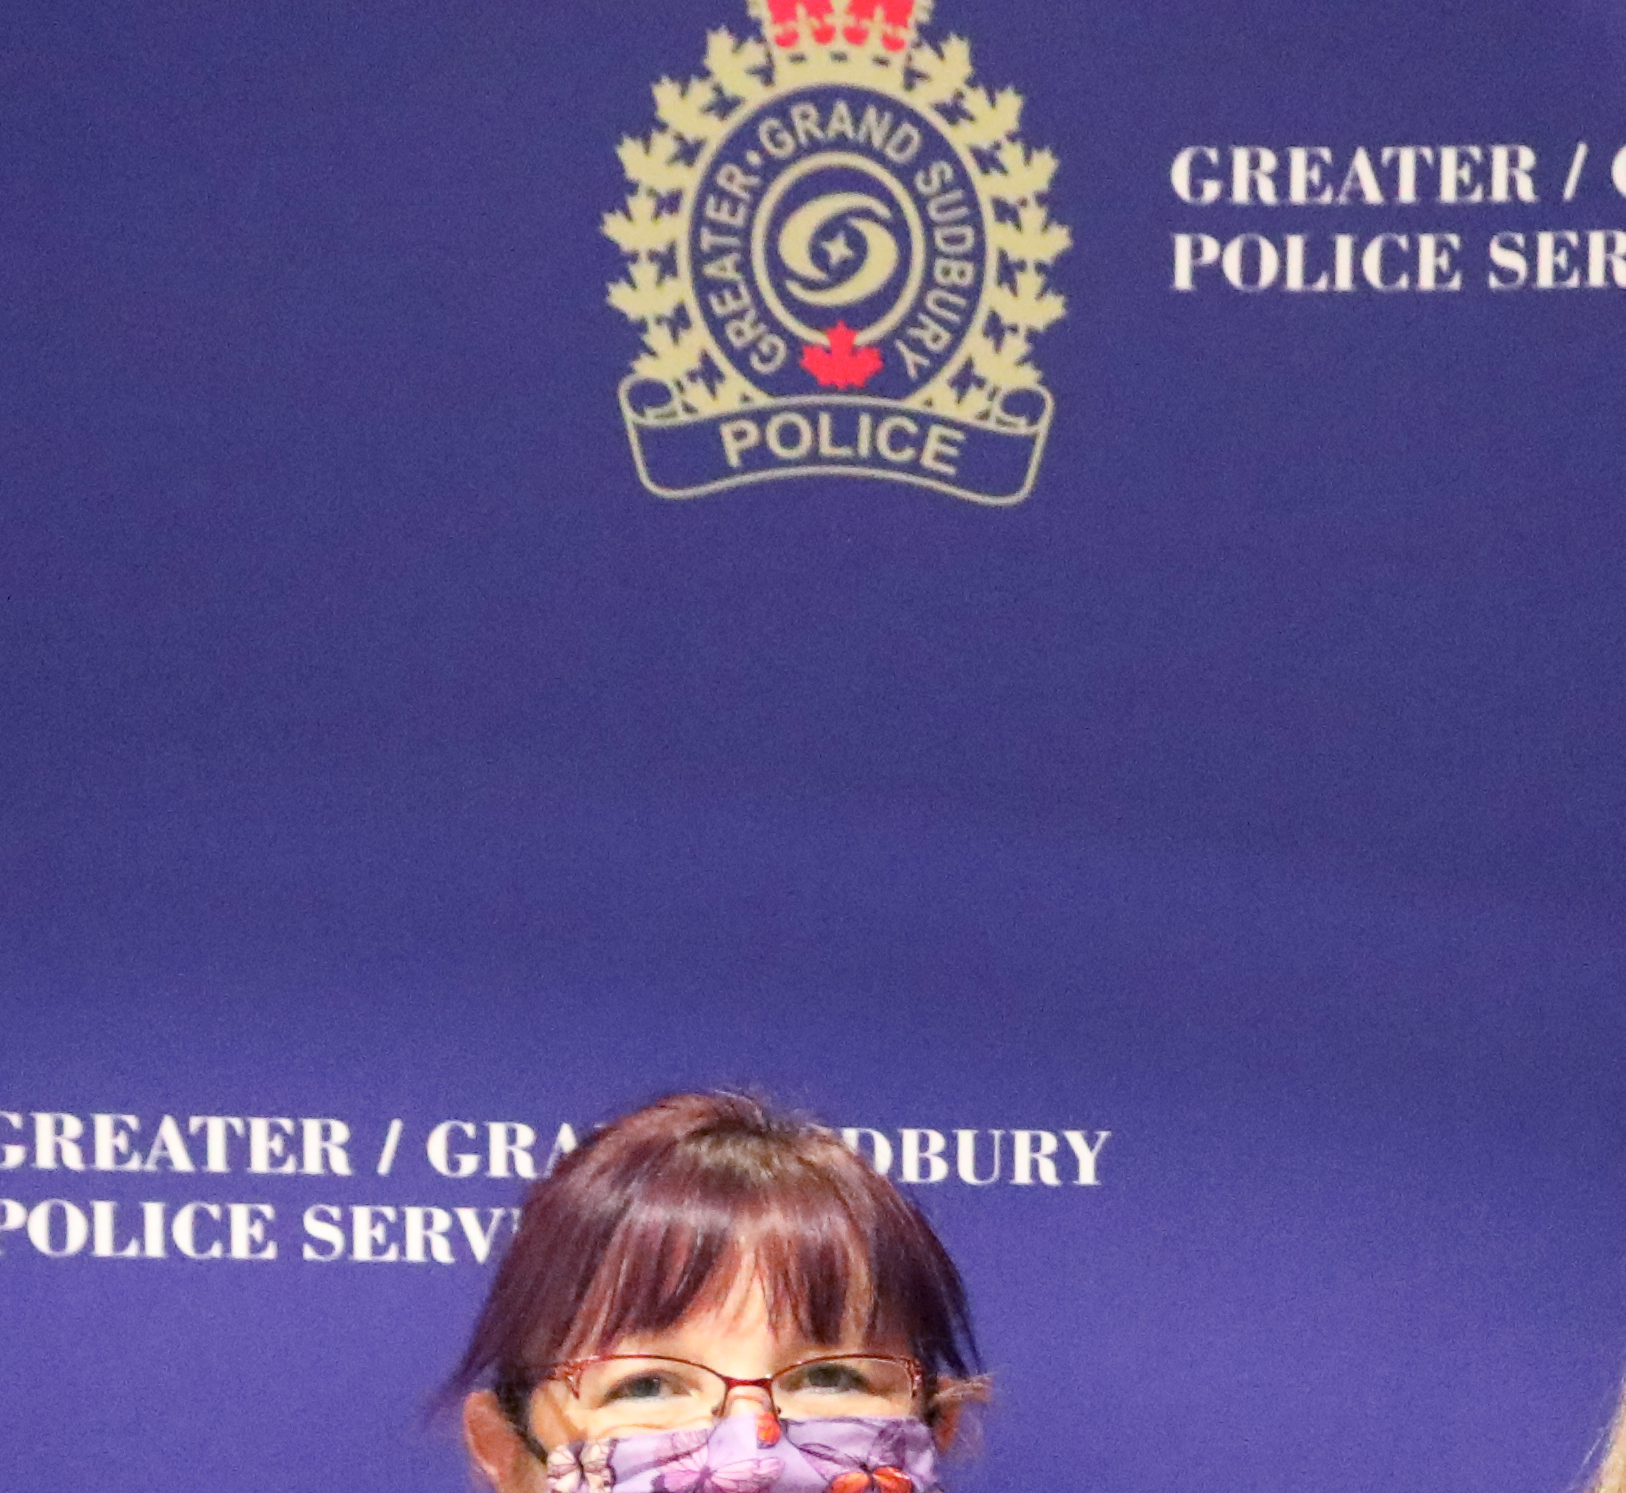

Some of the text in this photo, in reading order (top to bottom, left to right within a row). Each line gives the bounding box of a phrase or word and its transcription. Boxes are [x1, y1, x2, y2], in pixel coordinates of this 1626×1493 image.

[1170, 144, 1537, 206] GREATER
[1562, 142, 1589, 201] /
[699, 100, 975, 379] GREATER GRAND SUDBURY
[1173, 233, 1462, 292] POLICE
[718, 412, 966, 476] POLICE
[376, 1118, 404, 1177] /
[426, 1119, 579, 1179] GRA
[840, 1127, 1112, 1187] DBURY
[300, 1203, 522, 1267] SERV
